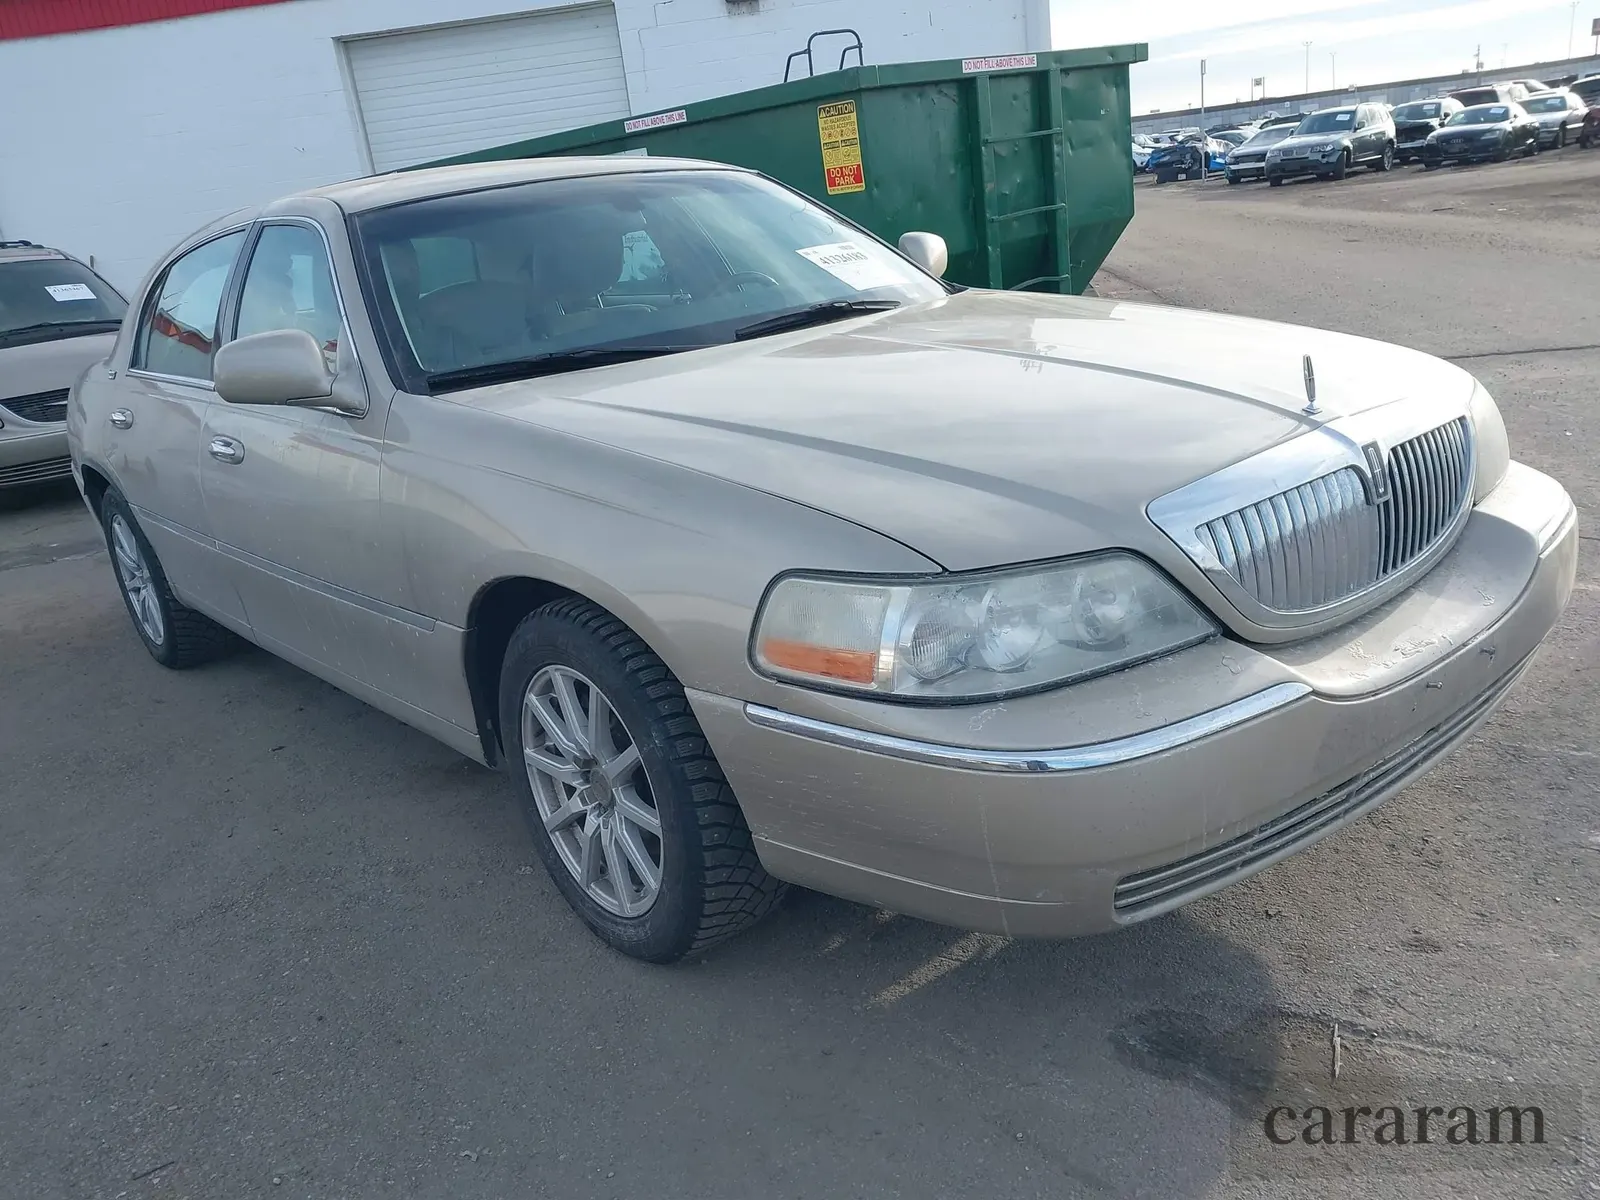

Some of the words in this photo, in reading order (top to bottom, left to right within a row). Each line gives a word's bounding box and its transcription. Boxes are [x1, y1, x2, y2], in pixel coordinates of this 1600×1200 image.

[964, 61, 972, 71] DO
[973, 60, 984, 70] NOT
[984, 59, 995, 69] FILL
[996, 58, 1013, 68] ABOVE
[1013, 57, 1025, 66] THIS
[1025, 56, 1036, 65] LINE
[825, 102, 854, 117] CAUTION
[626, 122, 633, 131] DO
[632, 121, 641, 129] NOT
[641, 119, 650, 127] FILL
[650, 116, 665, 125] ABOVE
[665, 114, 675, 122] THIS
[675, 111, 685, 120] LINE
[830, 168, 841, 178] DO
[842, 165, 858, 176] NOT
[835, 175, 856, 186] PARK
